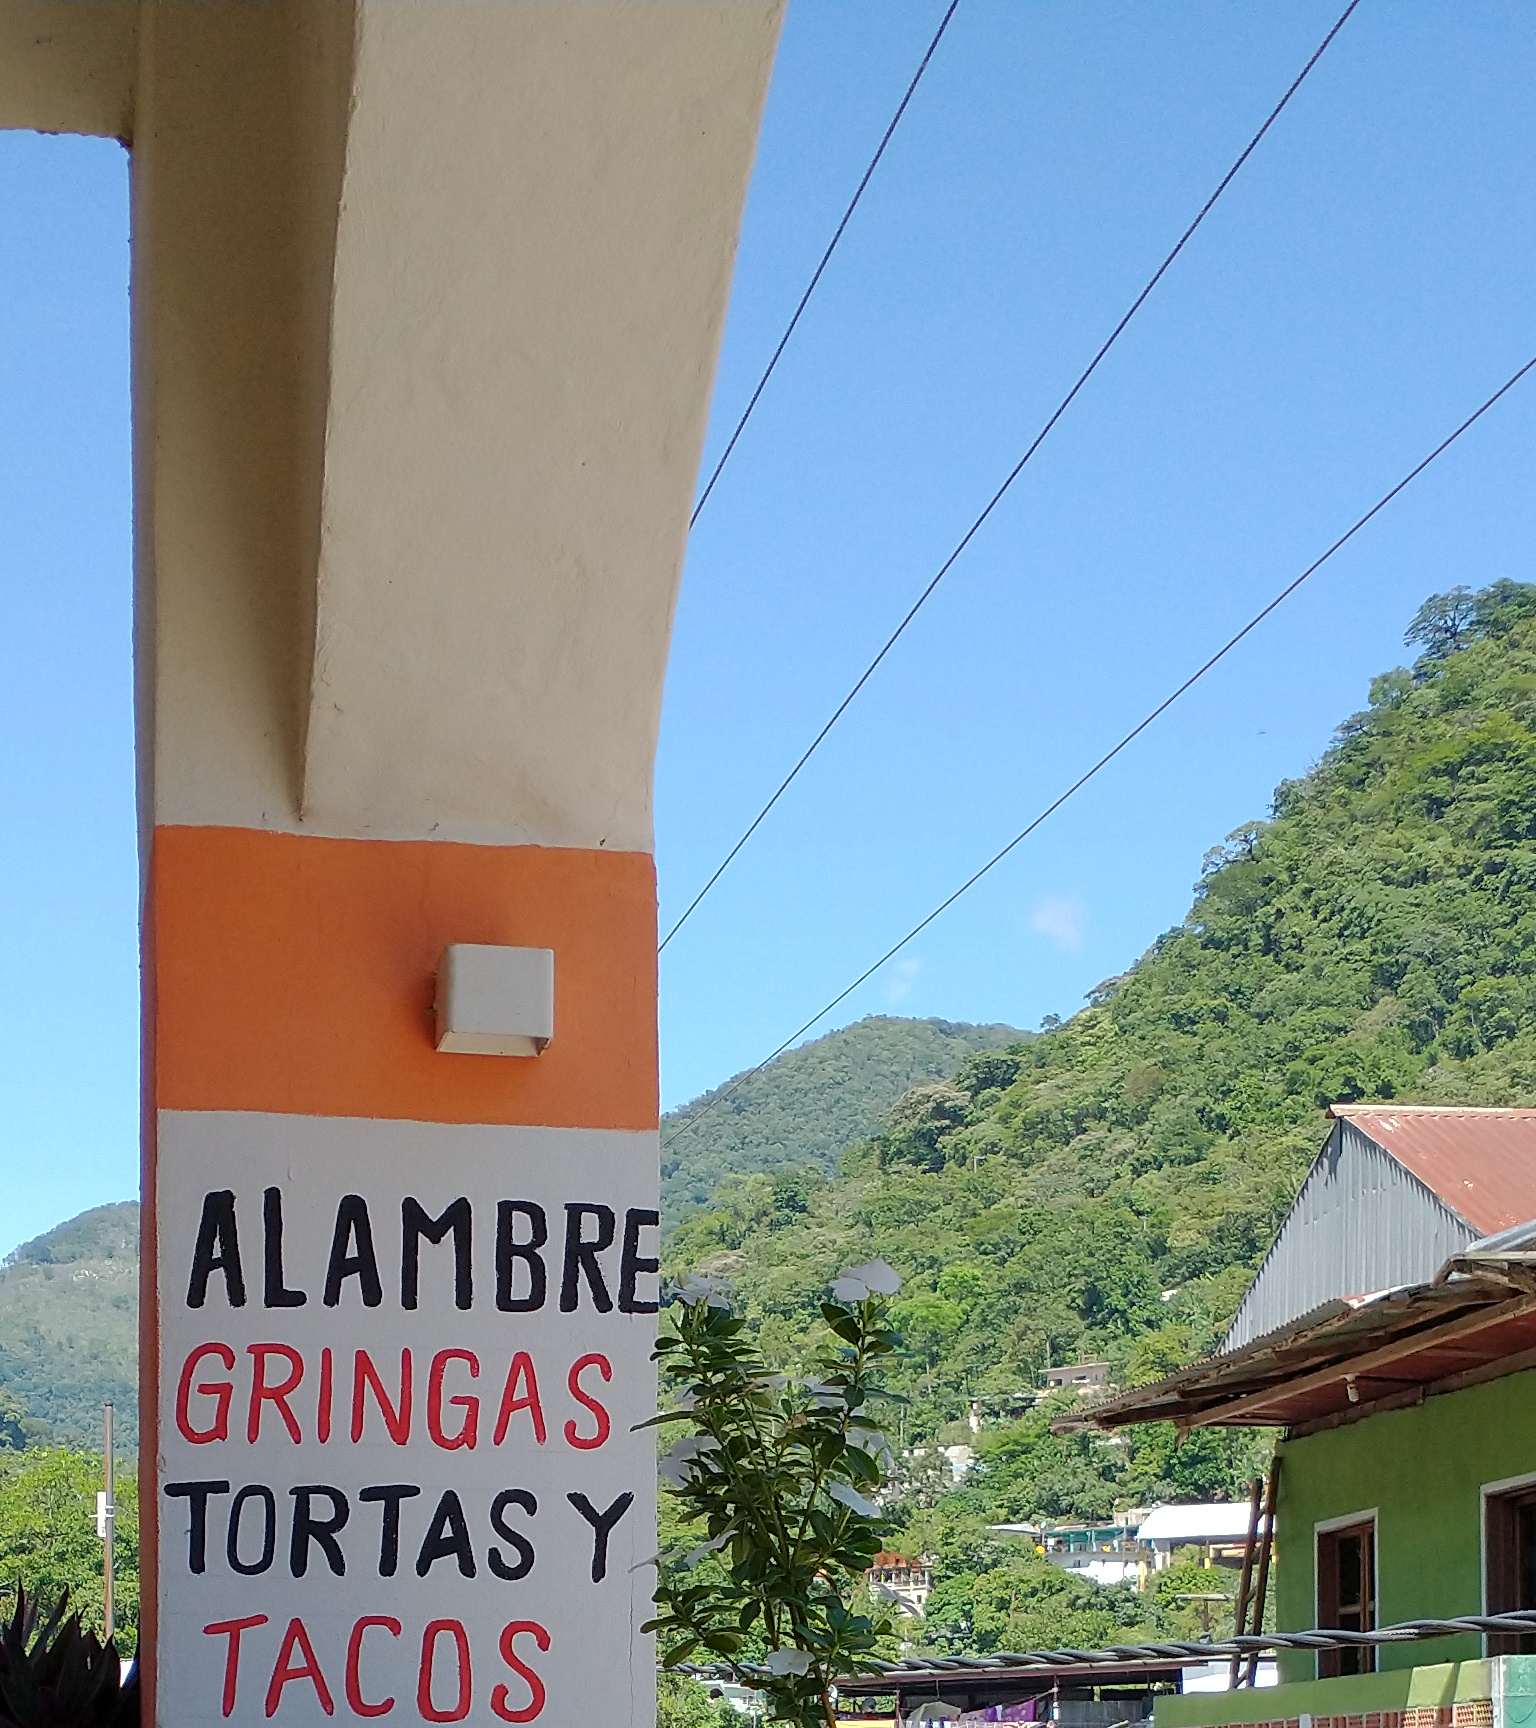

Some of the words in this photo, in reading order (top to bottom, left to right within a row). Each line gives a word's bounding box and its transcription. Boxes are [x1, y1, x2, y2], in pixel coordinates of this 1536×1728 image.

[186, 1186, 659, 1315] ALAMBRE
[175, 1341, 612, 1451] GRINGAS
[163, 1479, 538, 1582] TORTAS
[566, 1490, 634, 1584] Y
[202, 1614, 551, 1723] TACOS
